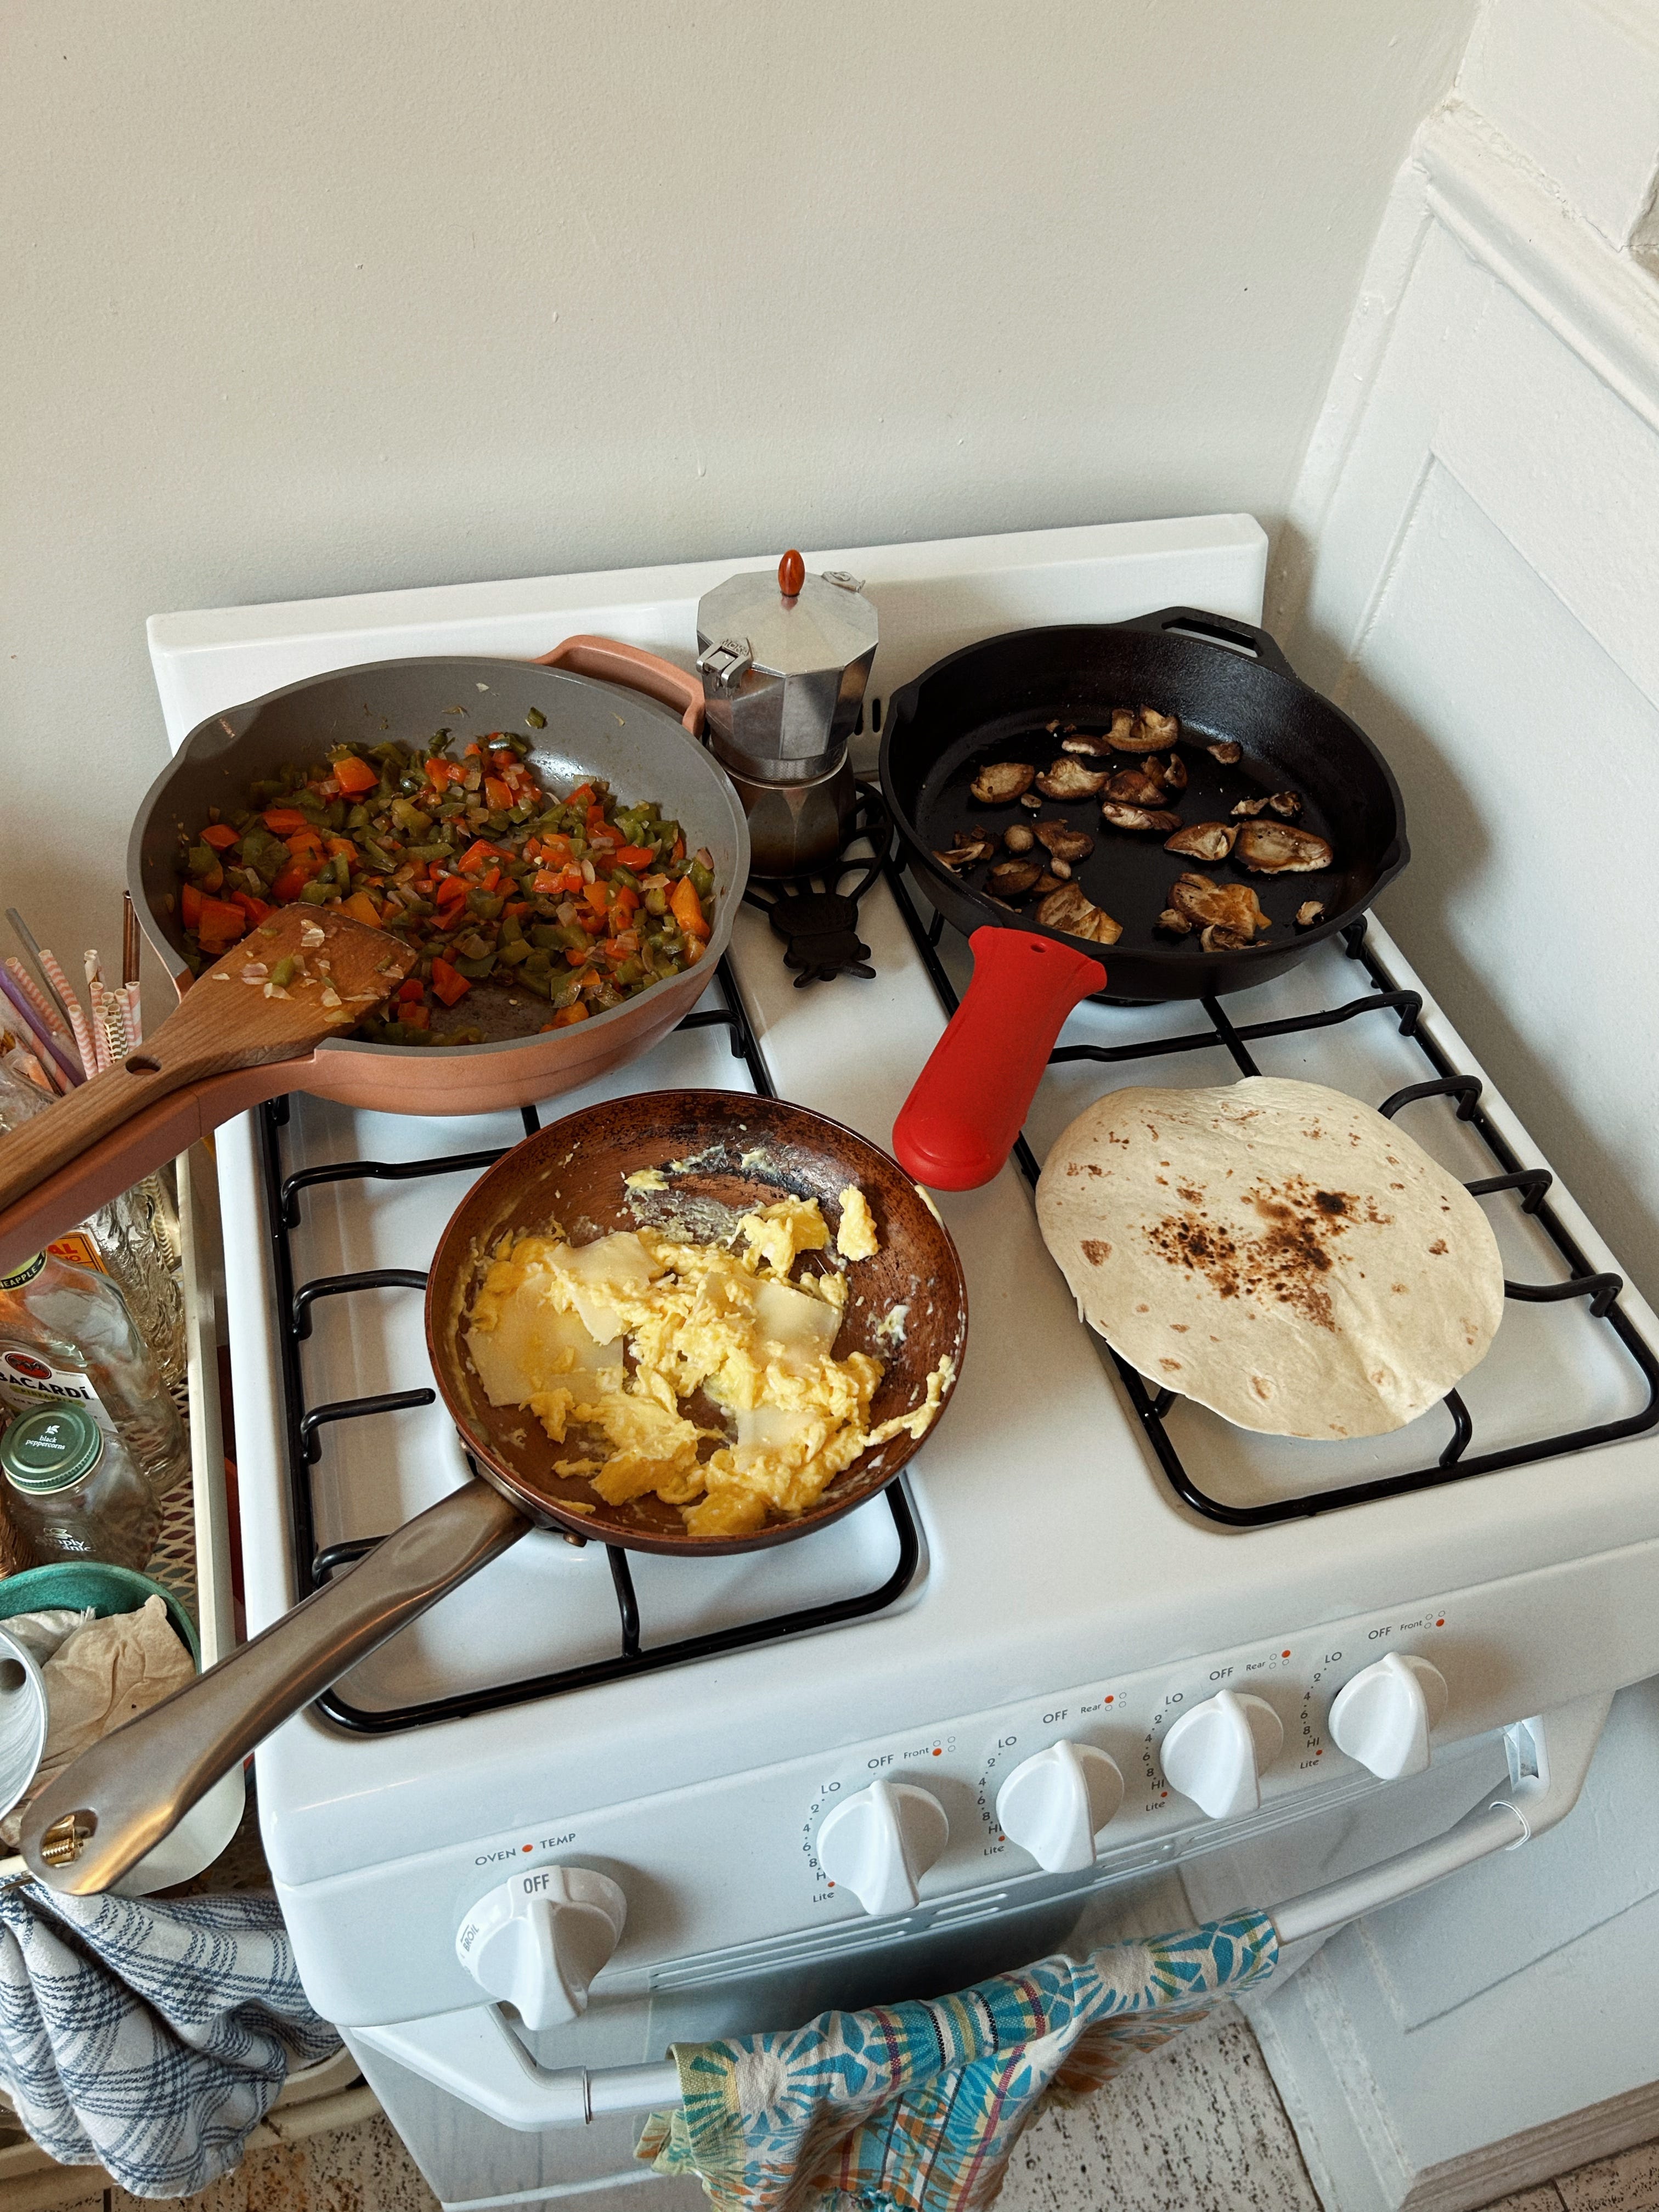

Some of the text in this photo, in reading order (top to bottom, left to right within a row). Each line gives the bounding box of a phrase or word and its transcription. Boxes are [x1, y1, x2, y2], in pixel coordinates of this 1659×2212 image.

[720, 639, 749, 657] MOKA
[25, 1439, 65, 1449] peppercorns
[1368, 1620, 1423, 1639] OFF Front
[1325, 1651, 1342, 1663] LO
[1210, 1661, 1266, 1680] OFF Rear
[1313, 1673, 1321, 1682] 2
[1166, 1693, 1183, 1705] LO
[1304, 1692, 1311, 1700] 4
[1043, 1703, 1101, 1723] OFF Rear
[1300, 1710, 1308, 1719] 6
[1154, 1714, 1162, 1724] 2
[1303, 1726, 1311, 1735] 8
[998, 1736, 1017, 1748] LO
[1145, 1734, 1152, 1742] 4
[1307, 1737, 1319, 1748] HI
[867, 1748, 929, 1769] OFF Front
[1143, 1753, 1150, 1761] 6
[988, 1758, 995, 1767] 2
[1300, 1759, 1319, 1769] Lite
[1146, 1768, 1154, 1777] 8
[979, 1778, 986, 1786] 4
[1152, 1779, 1164, 1790] HI
[821, 1782, 840, 1794] LO
[978, 1796, 985, 1804] 6
[811, 1804, 819, 1814] 2
[1146, 1801, 1165, 1812] Lite
[982, 1812, 990, 1821] 8
[803, 1824, 810, 1832] 4
[475, 1833, 576, 1865] OVEN TEMP
[803, 1843, 811, 1851] 6
[984, 1846, 1005, 1855] Lite
[809, 1858, 817, 1867] 8
[816, 1871, 826, 1881] H
[523, 1874, 550, 1894] OFF
[813, 1892, 834, 1902] Lite
[463, 1924, 479, 1951] BROIL
